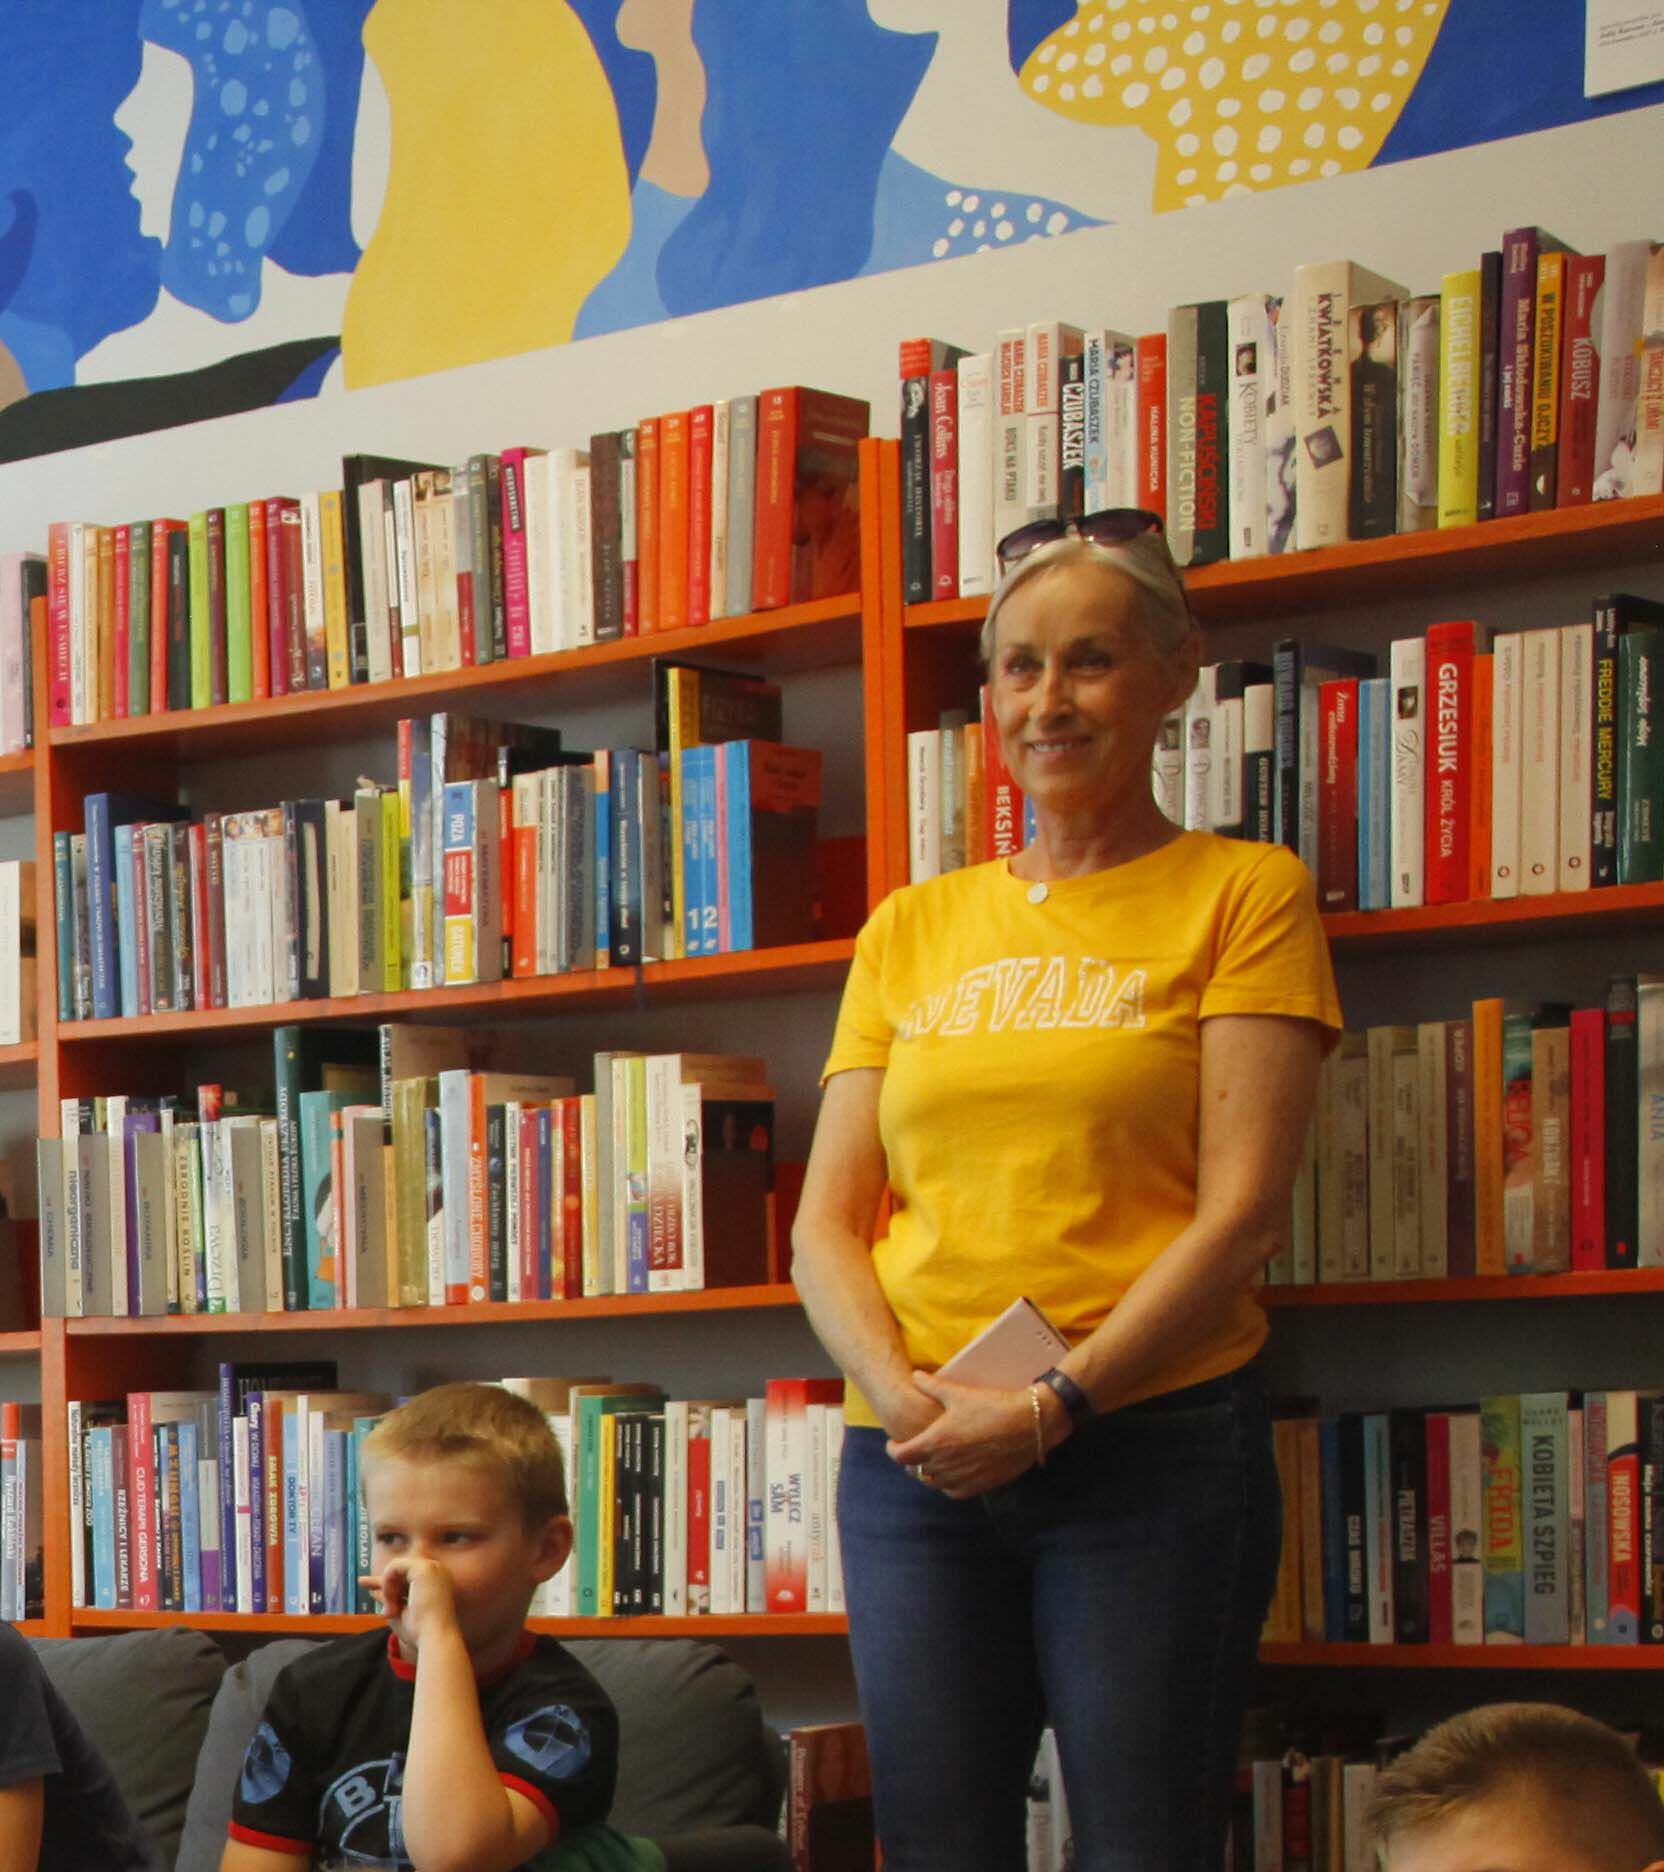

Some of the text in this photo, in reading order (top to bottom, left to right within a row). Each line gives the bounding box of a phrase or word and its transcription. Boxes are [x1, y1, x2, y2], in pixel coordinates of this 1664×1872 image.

[1316, 293, 1333, 419] KWIATKOWSKA
[1516, 299, 1530, 340] Maria
[1535, 309, 1555, 399] POSZUKIWANIU
[1088, 339, 1101, 444] MARIA CZUBASZEK
[1278, 366, 1291, 405] DUDZIAK
[1570, 337, 1593, 400] KOBUSZ
[934, 383, 955, 457] Joan Collins
[1062, 383, 1085, 469] CZUBASZEK
[1148, 406, 1160, 491] HALINA KUNICKA
[1240, 382, 1259, 445] KOBIETY
[1177, 397, 1196, 531] NON-FICTION
[1196, 393, 1221, 529] KAPUŚCIŃSKI
[1437, 663, 1459, 857] GRZESIUK KRÓL ŻYCIA
[1597, 659, 1614, 799] FREDDIE MERCURY
[450, 813, 466, 842] POZA
[688, 908, 699, 930] 1
[704, 906, 717, 928] 2
[46, 1212, 56, 1257] CHEMIA
[66, 1170, 81, 1269] nieorganiczna
[179, 1155, 193, 1276] ZBRODNIE ROŚLIN
[279, 1156, 293, 1256] ENCYKLOPEDIA
[470, 1223, 484, 1278] CHOROBY
[117, 1489, 130, 1591] RZEŹNICY LEKARZE
[135, 1466, 148, 1583] CUD TERAPII GERSONA
[268, 1456, 278, 1545] SMAK ZDROWIA
[287, 1476, 297, 1533] DOKTOR TY
[771, 1484, 785, 1513] SAM
[787, 1474, 801, 1522] WYLECZ
[1532, 1435, 1556, 1594] KOBIETA SZPIEG
[1611, 1472, 1633, 1562] NOSOWSKA
[1429, 1514, 1447, 1573] VILLAS
